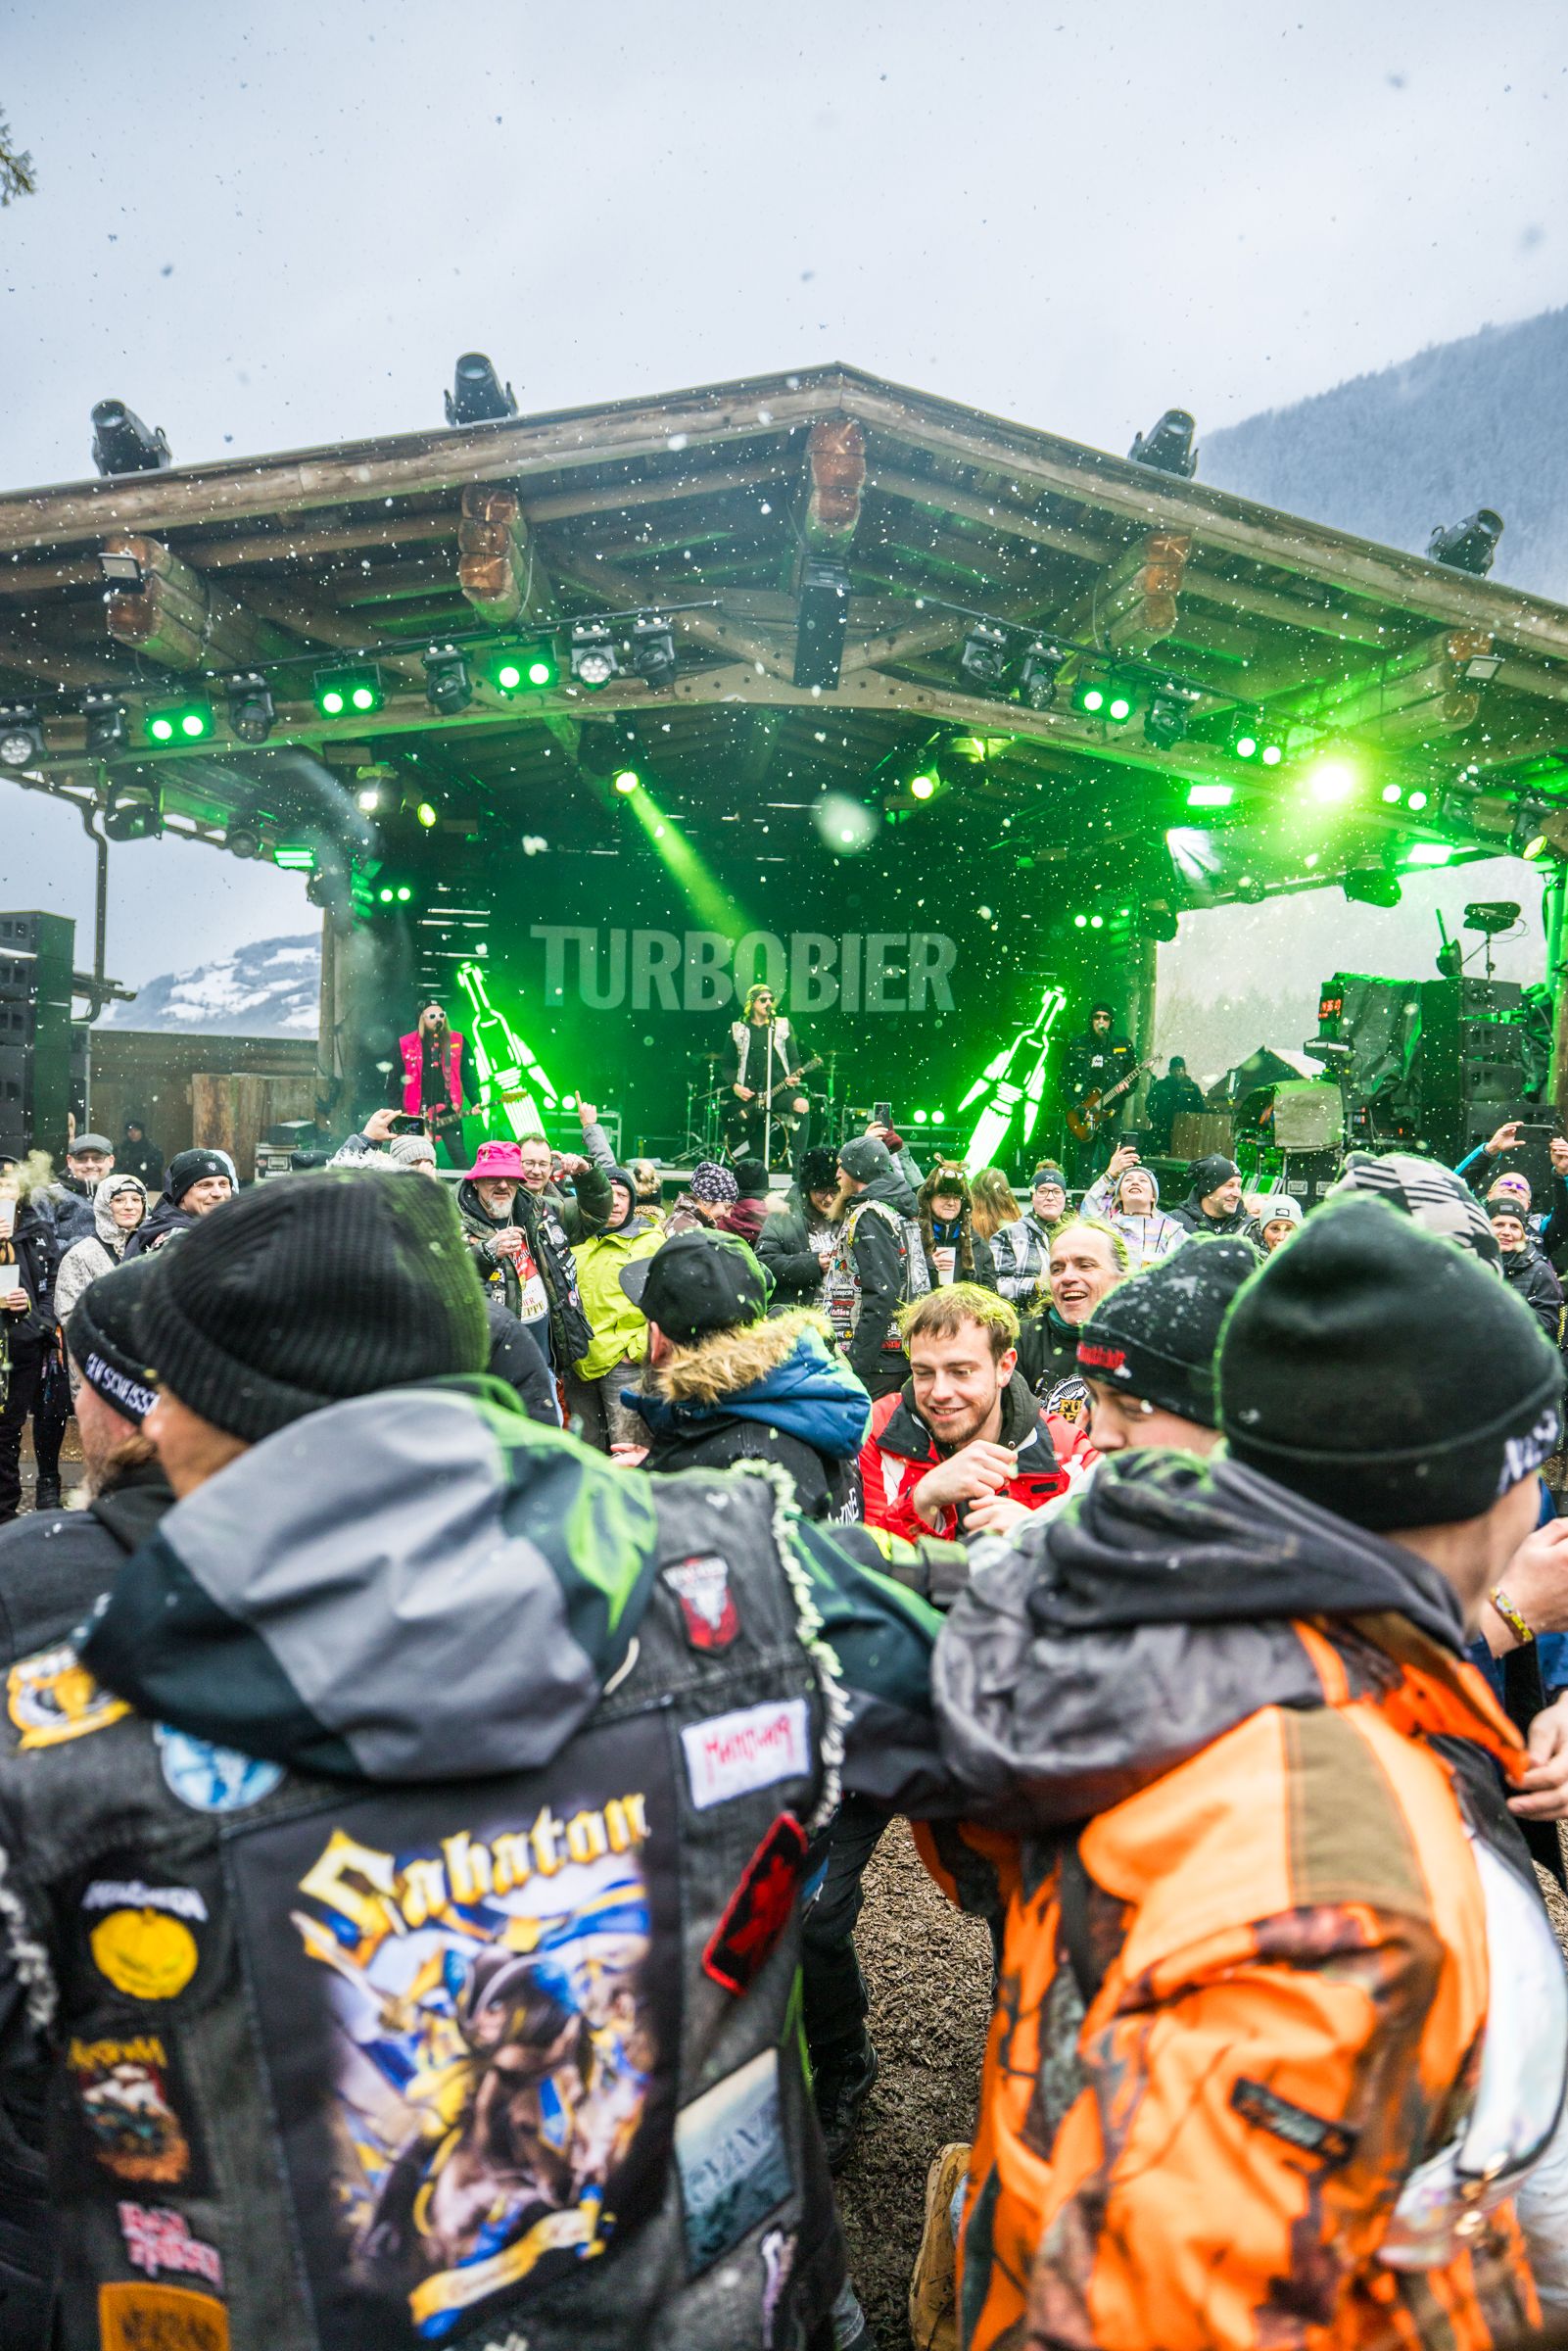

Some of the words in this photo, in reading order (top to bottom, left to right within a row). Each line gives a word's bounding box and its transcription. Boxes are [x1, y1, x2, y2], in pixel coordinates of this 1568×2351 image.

[531, 925, 957, 1012] TURBOBIER
[1060, 1399, 1083, 1413] FU
[299, 1793, 650, 1935] Sabaton
